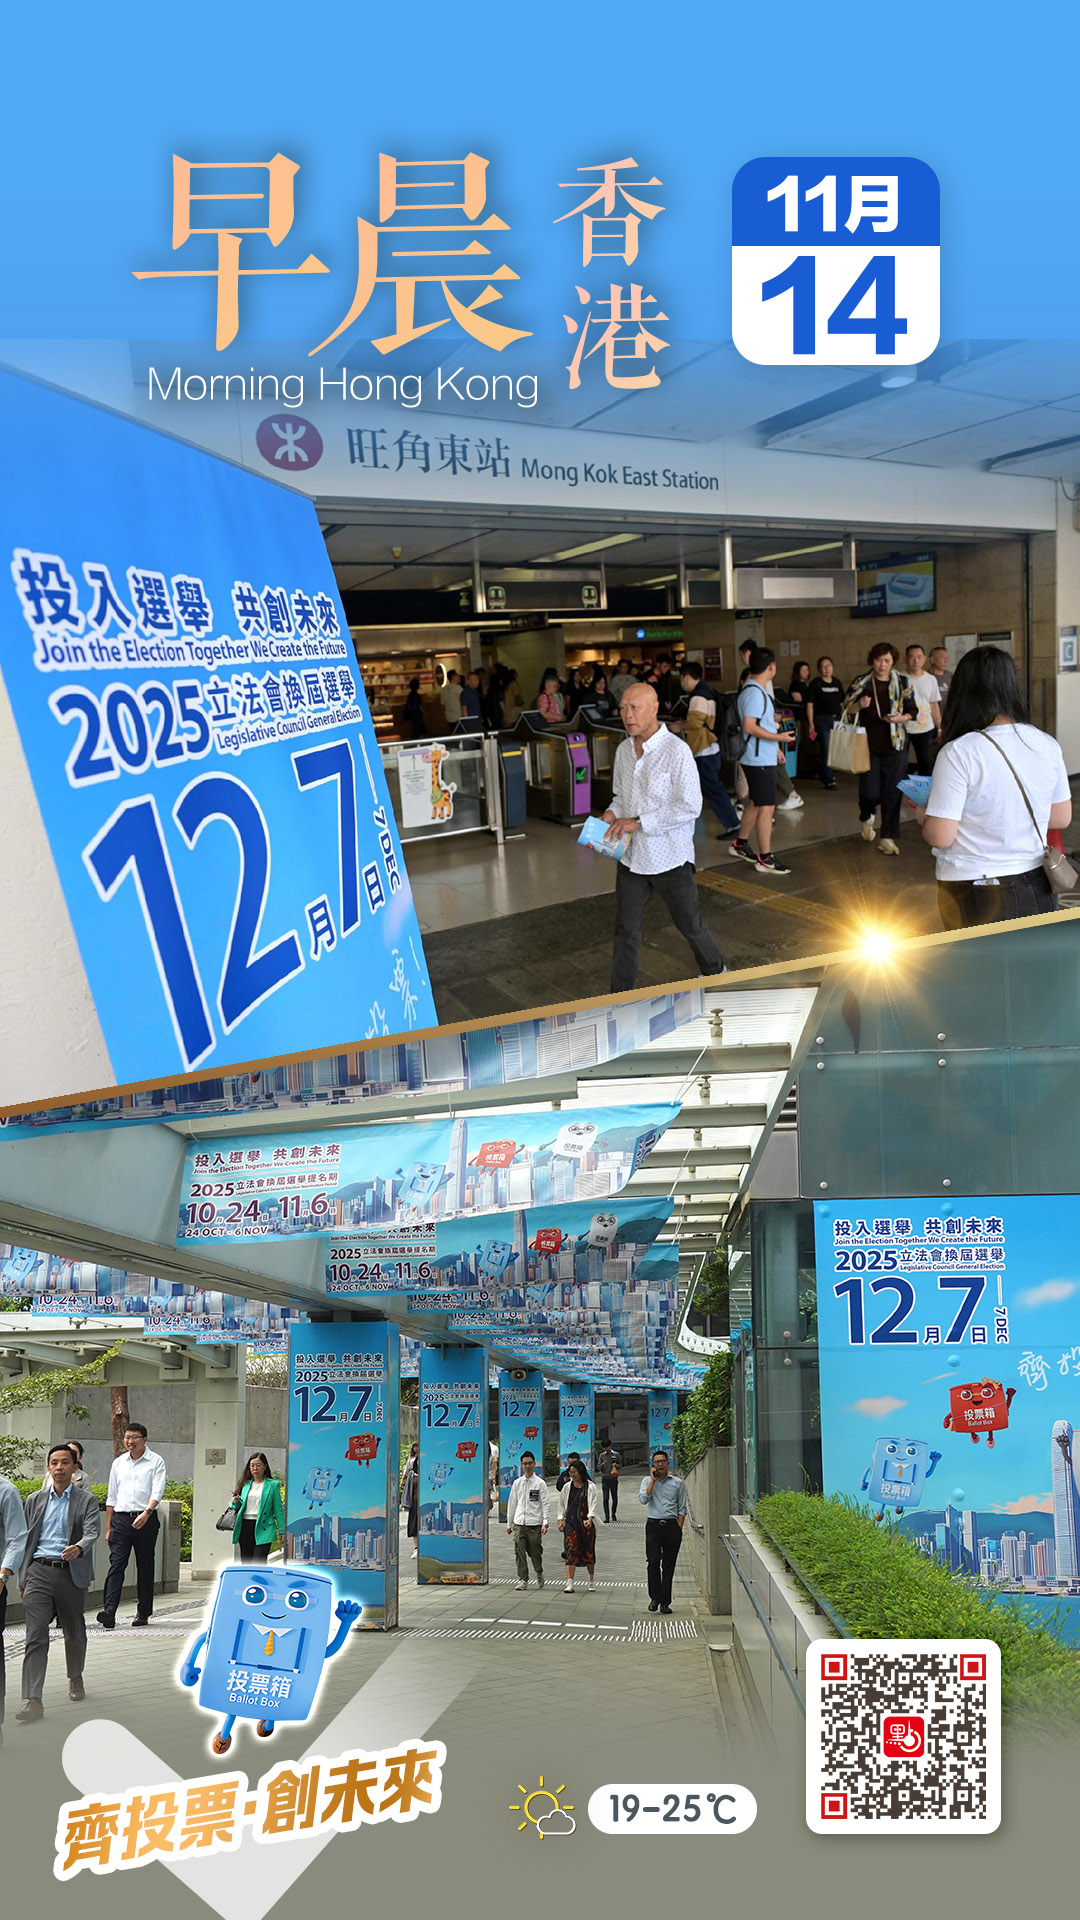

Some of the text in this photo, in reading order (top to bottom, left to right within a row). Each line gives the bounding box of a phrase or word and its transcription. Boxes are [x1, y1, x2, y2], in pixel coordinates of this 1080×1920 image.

[347, 428, 719, 490] 旺角東站 Mong Kok East Station
[19, 556, 338, 634] 投入選舉 共創未來
[41, 637, 346, 665] Join the Election Together We Create the Future
[217, 708, 361, 750] Legislative Council General Election
[375, 809, 400, 892] 7 DEC
[194, 1144, 341, 1167] 投入選舉 共創未來
[219, 1165, 244, 1173] Election
[245, 1162, 273, 1171] Together
[186, 1229, 199, 1237] 24
[202, 1228, 225, 1236] OCT
[234, 1228, 241, 1236] 6
[244, 1226, 268, 1236] NOV
[834, 1217, 1002, 1236] 投入選舉 共創未來
[835, 1238, 850, 1246] Join
[851, 1237, 864, 1245] the
[865, 1237, 894, 1245] Election
[895, 1237, 927, 1247] Together
[940, 1236, 965, 1244] Create
[900, 1263, 932, 1272] Legislative
[932, 1263, 955, 1271] Council
[994, 1307, 1008, 1343] 7 DEC
[964, 1408, 995, 1421] 投票箱
[968, 1419, 982, 1427] Ballot
[880, 1483, 912, 1498] 投票箱
